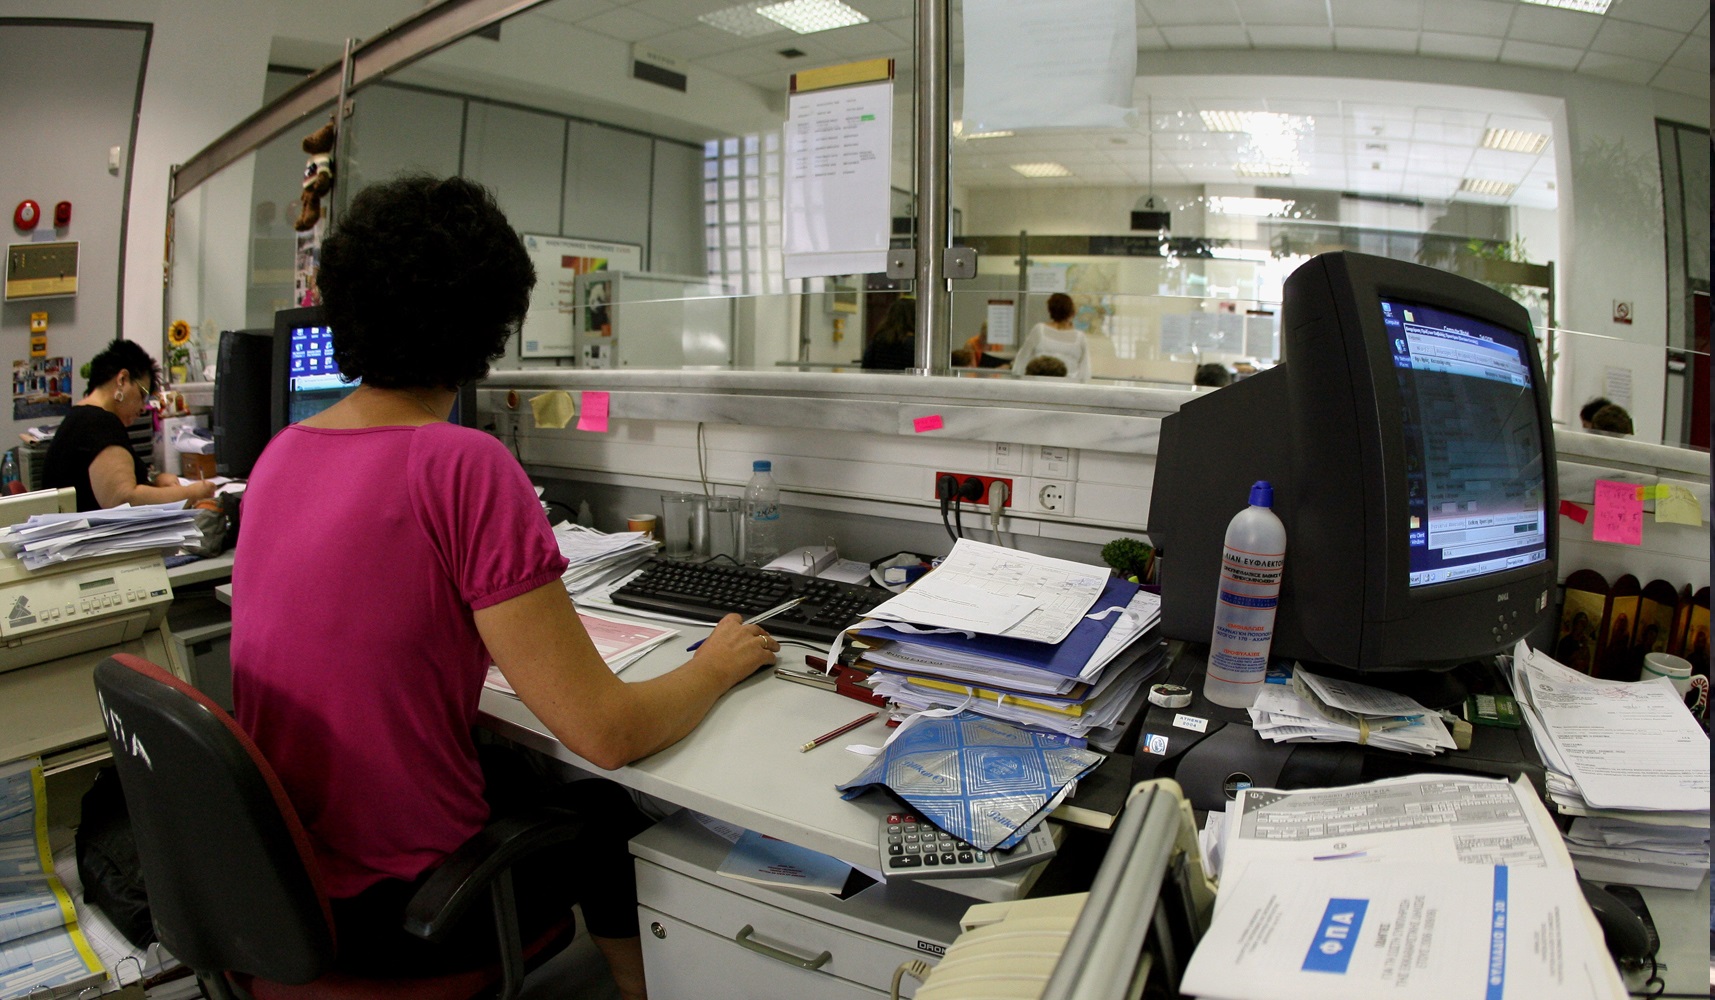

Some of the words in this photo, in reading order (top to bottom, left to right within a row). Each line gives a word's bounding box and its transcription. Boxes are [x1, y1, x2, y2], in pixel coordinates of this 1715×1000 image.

[1145, 198, 1154, 210] 4
[1497, 593, 1509, 602] DELL
[1180, 716, 1202, 724] ATHENS
[1319, 912, 1355, 955] ΦΠΑ
